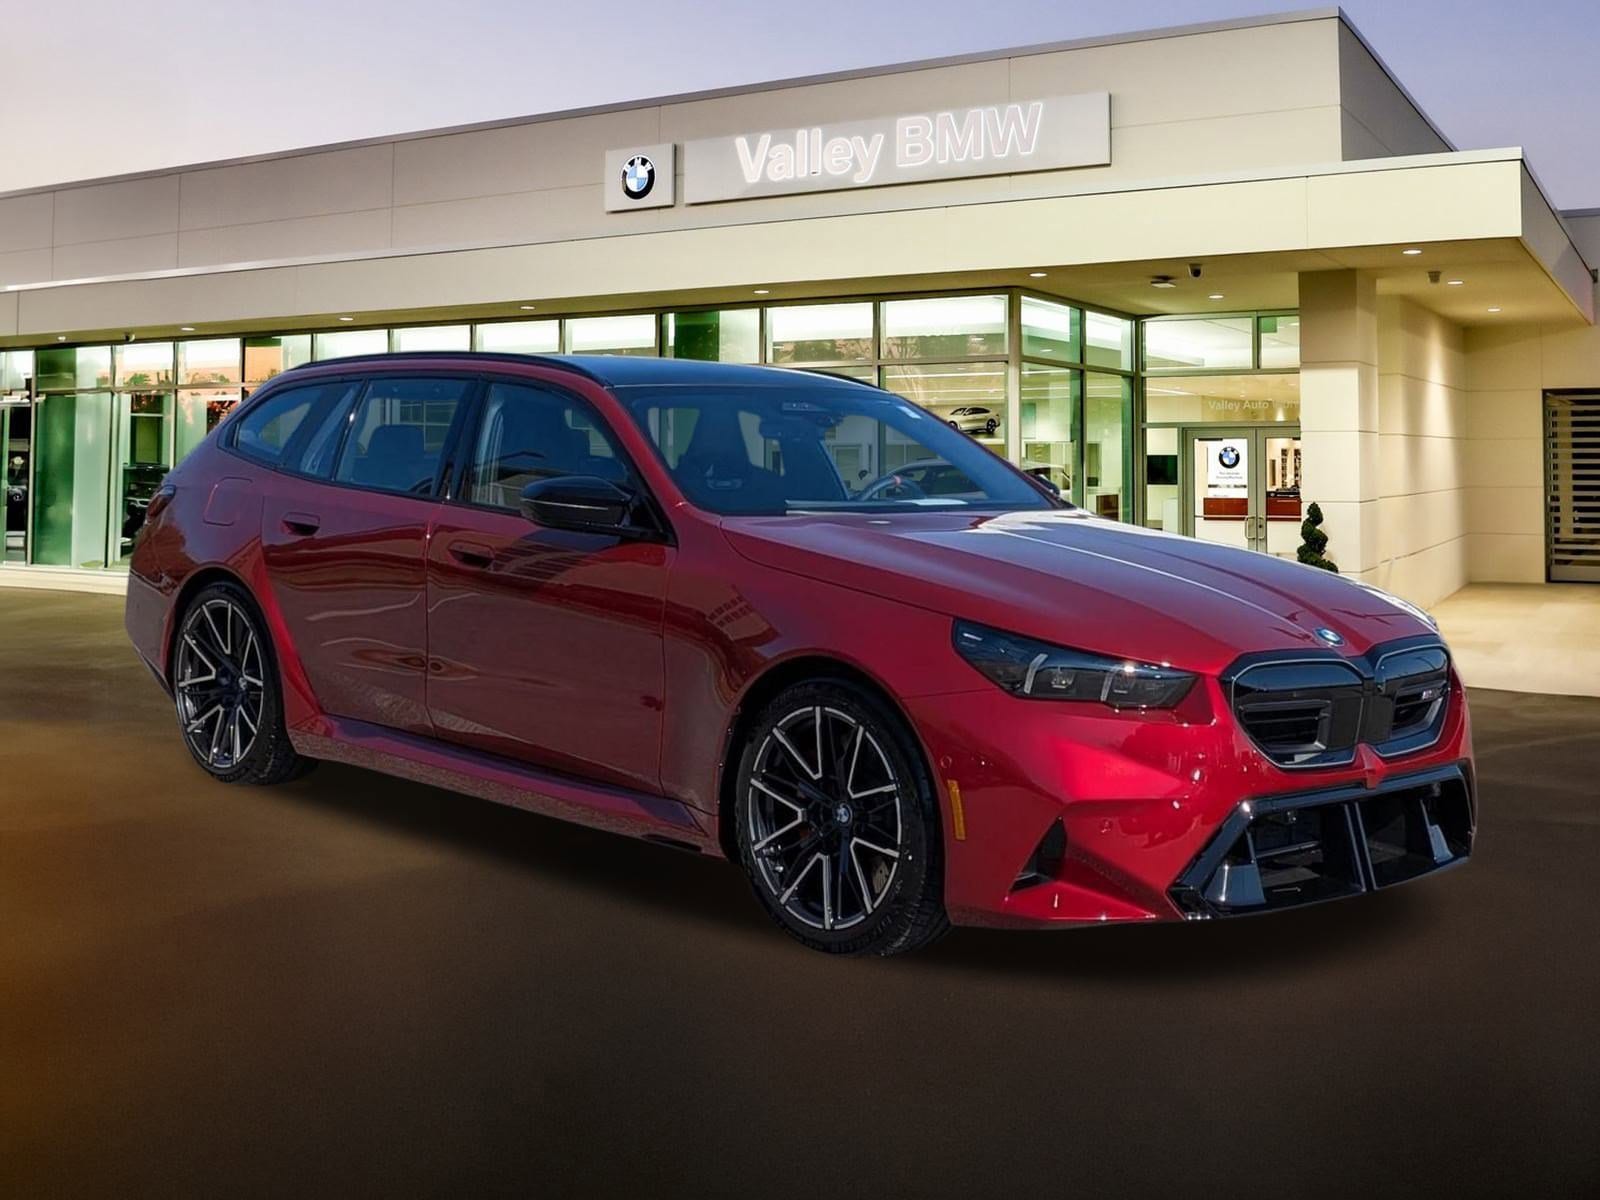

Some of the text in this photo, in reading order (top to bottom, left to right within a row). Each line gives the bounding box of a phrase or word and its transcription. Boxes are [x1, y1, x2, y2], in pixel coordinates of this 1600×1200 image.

[735, 102, 1044, 184] Valley BMW
[1208, 400, 1240, 412] Valley
[1243, 399, 1269, 409] Auto
